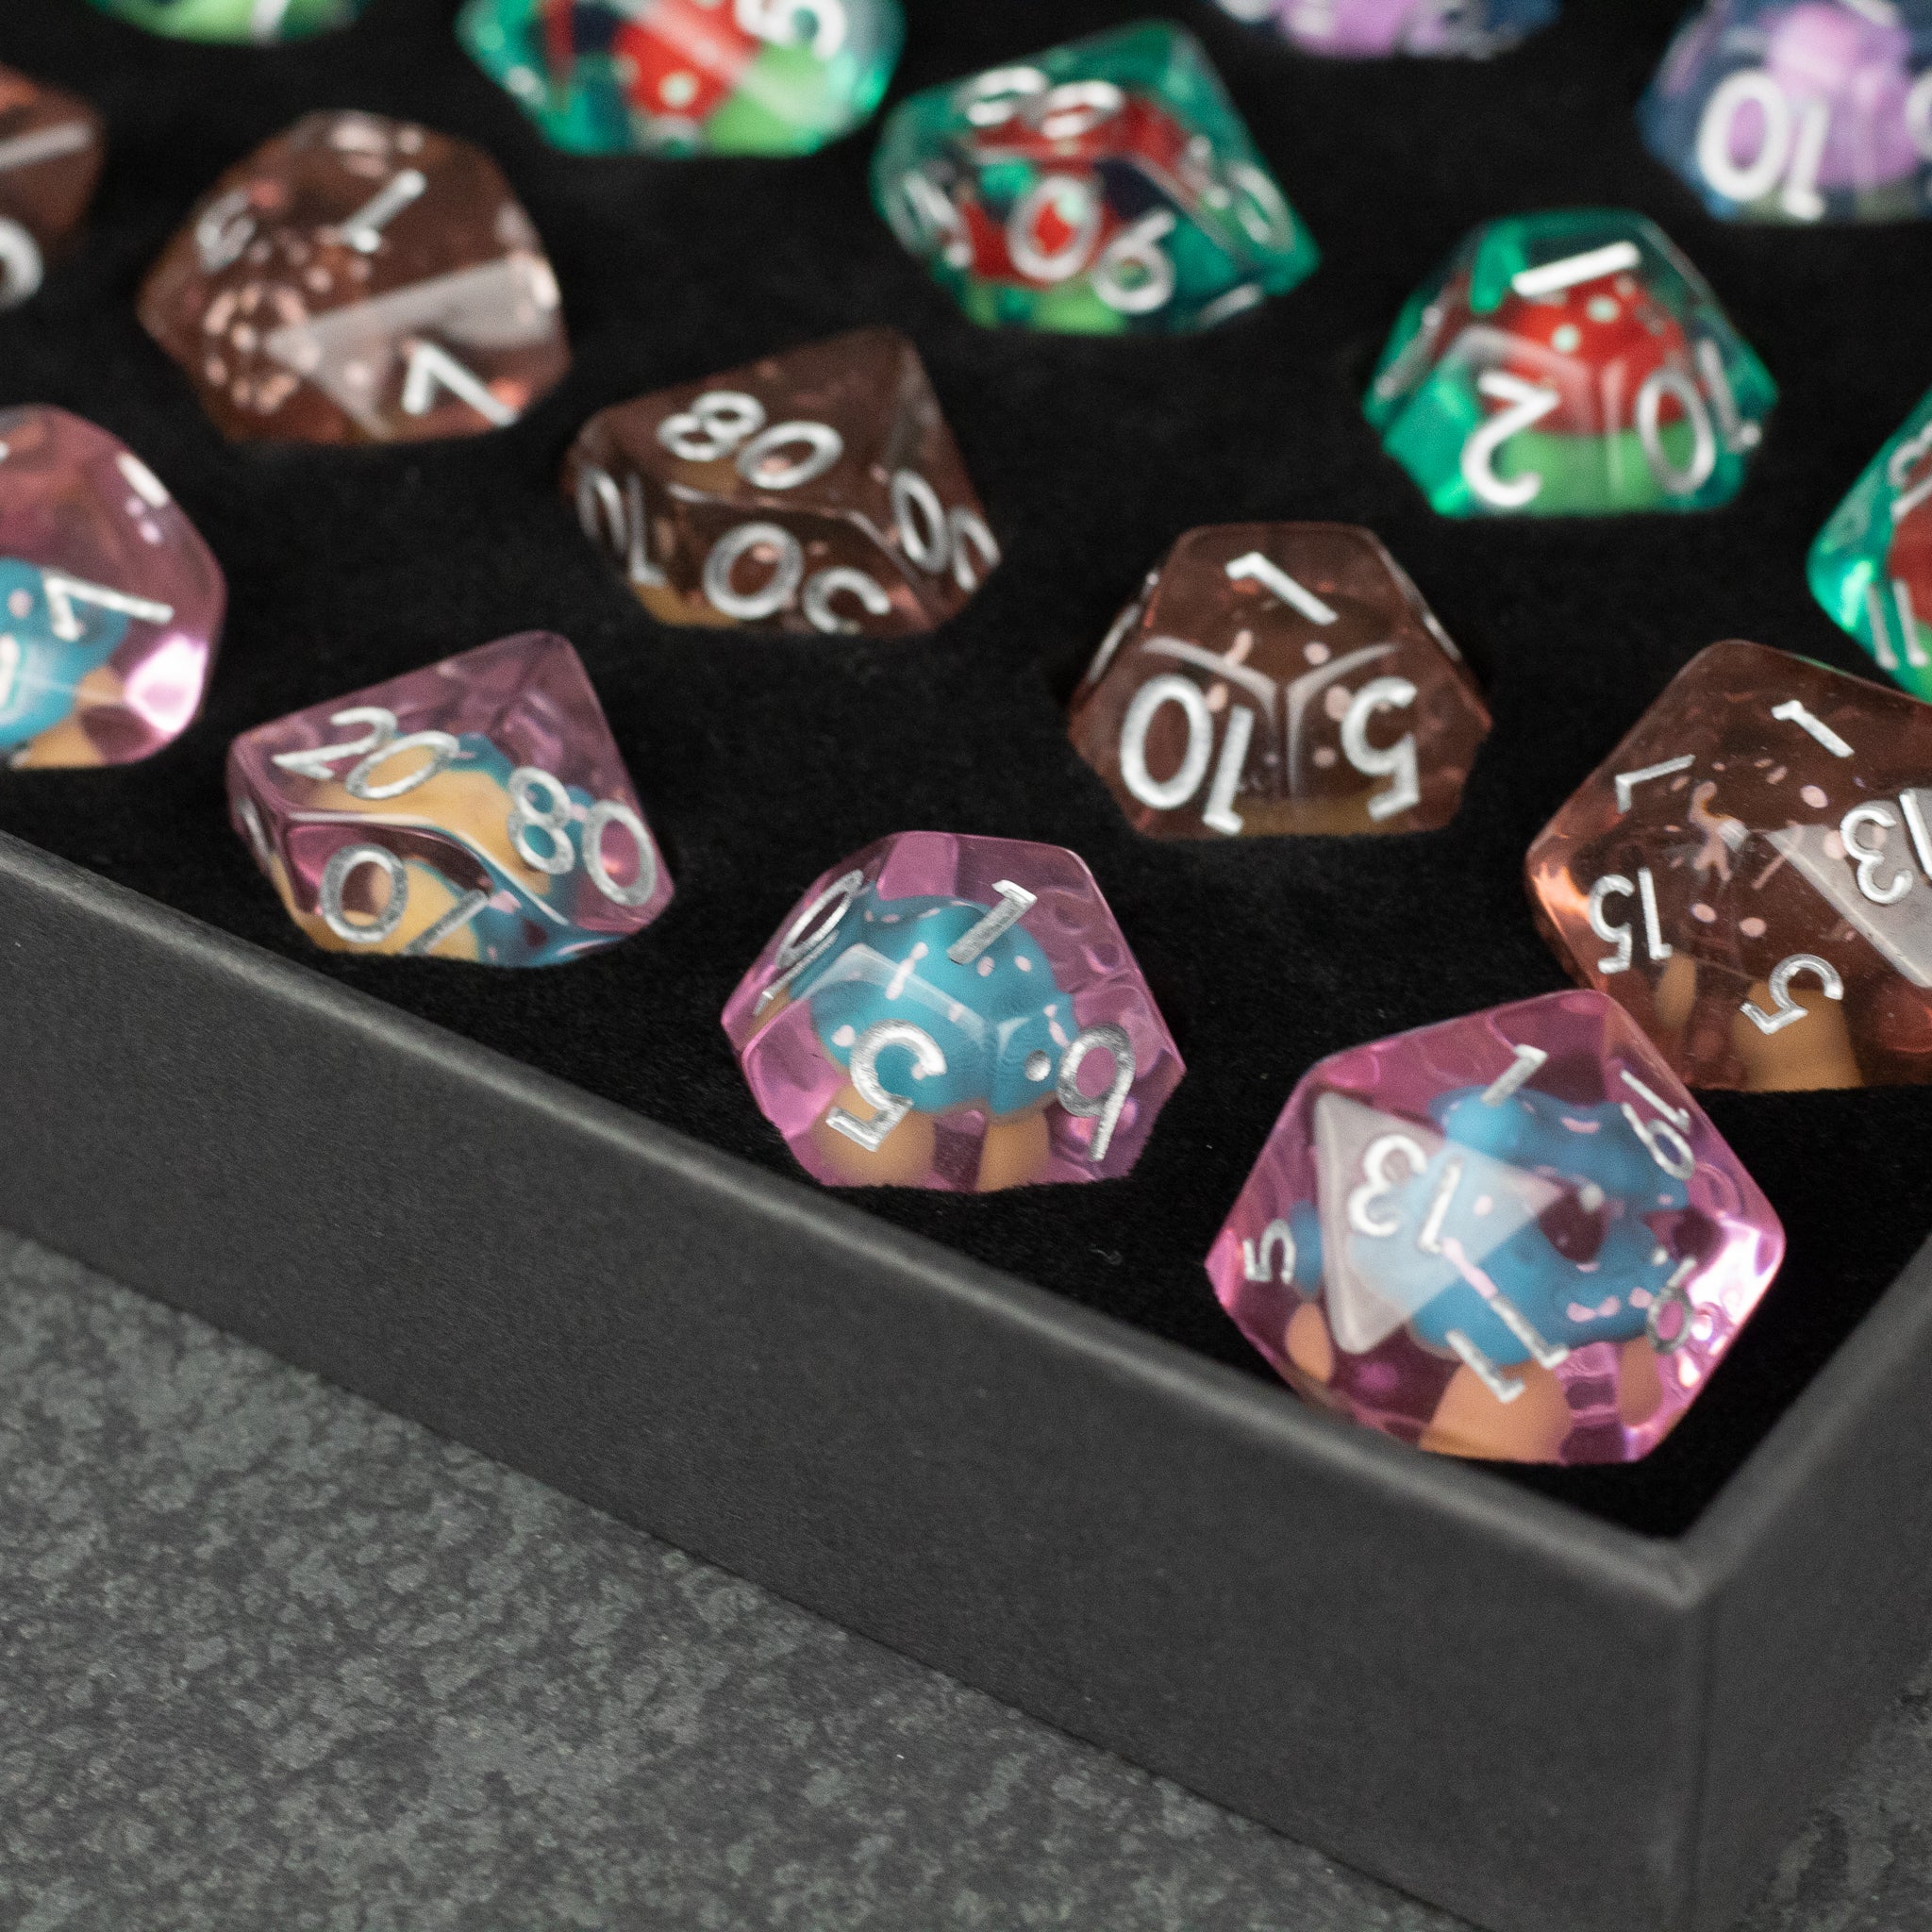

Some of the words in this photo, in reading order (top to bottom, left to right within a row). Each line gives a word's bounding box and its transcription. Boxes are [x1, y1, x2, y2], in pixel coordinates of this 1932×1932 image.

[658, 390, 842, 491] 80
[1225, 551, 1339, 625] 1
[273, 707, 459, 800] 20
[1120, 674, 1244, 835] 10
[1341, 675, 1421, 824] 5
[508, 766, 657, 907] 80
[946, 879, 1038, 965] 1
[1589, 867, 1674, 975] 15
[1740, 953, 1844, 1036] 5
[825, 1019, 946, 1153] 5
[1482, 1044, 1548, 1107] 1
[1348, 1134, 1462, 1253] 13
[1242, 1219, 1296, 1285] 5
